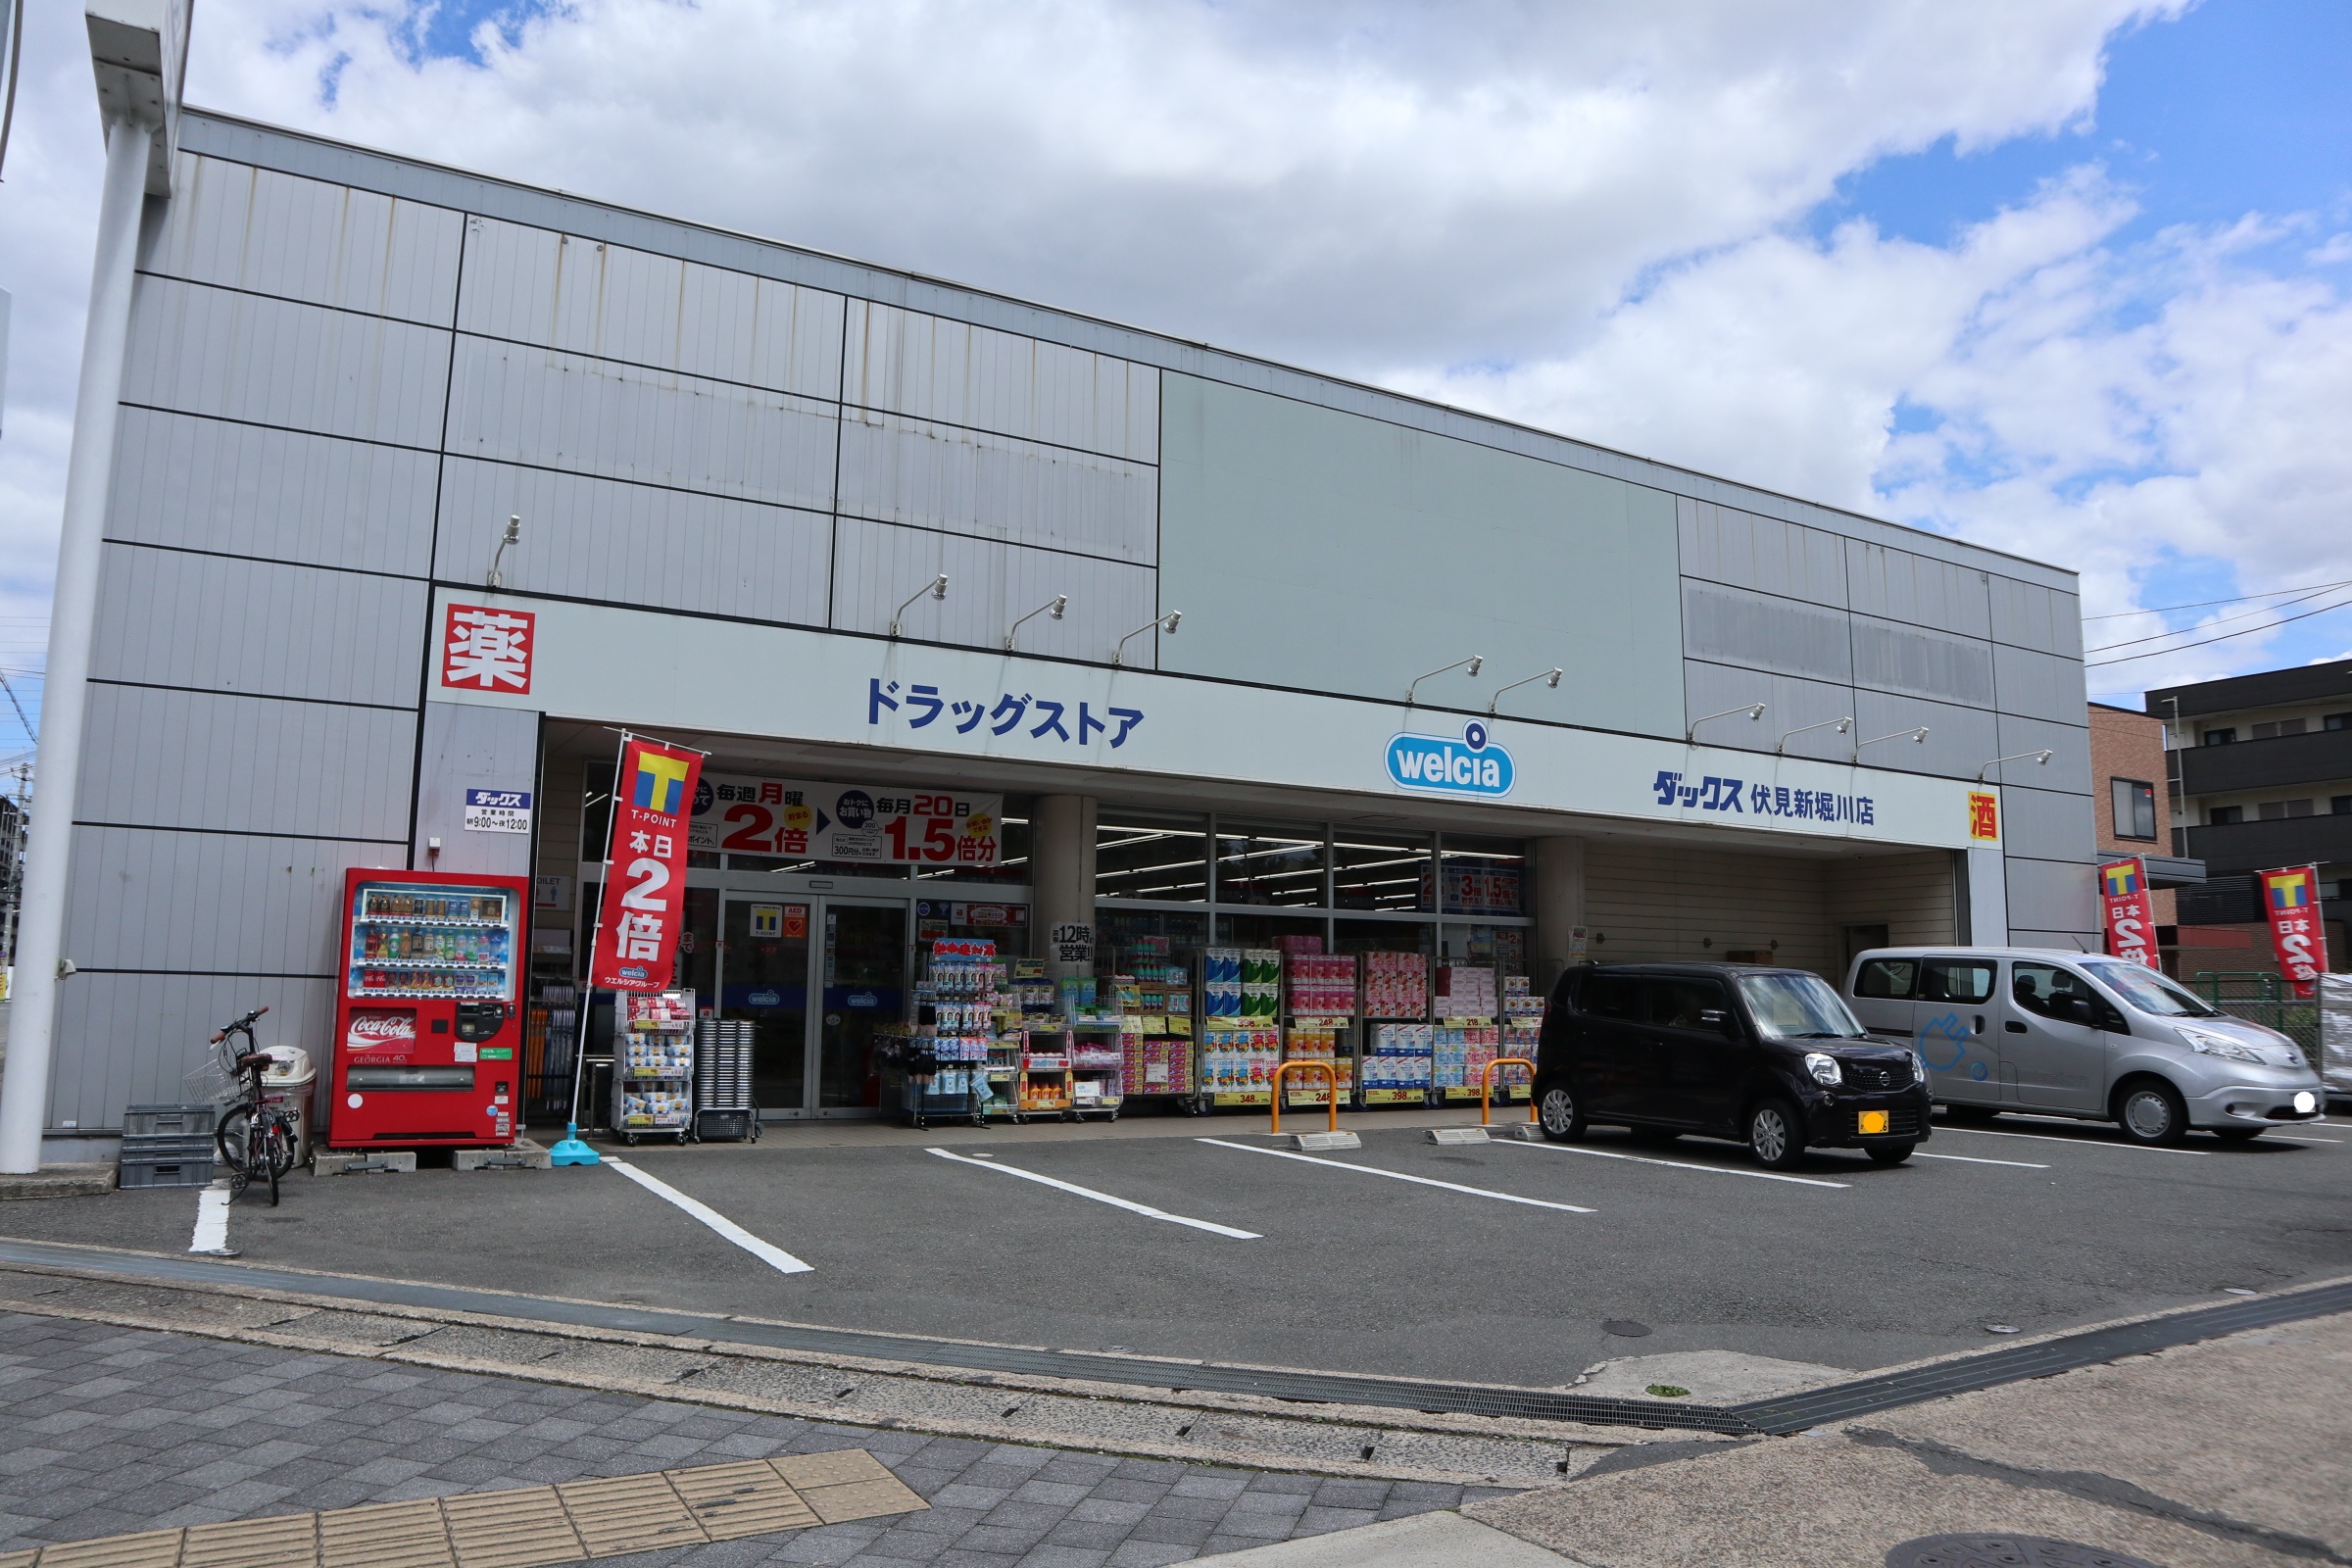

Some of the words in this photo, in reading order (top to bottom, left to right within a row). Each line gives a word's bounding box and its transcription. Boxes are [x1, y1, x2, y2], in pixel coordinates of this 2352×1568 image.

[447, 610, 528, 688] 薬
[868, 677, 1145, 749] ドラッグストア
[1396, 723, 1500, 788] welcia
[475, 791, 521, 807] ダックス
[716, 782, 804, 808] 毎週月曜
[876, 794, 970, 817] 毎月20日
[1653, 770, 1743, 813] ダックス
[1750, 783, 1875, 826] 伏見新堀川店
[481, 808, 514, 817] 営業時間
[631, 808, 676, 828] T-POINT
[839, 806, 872, 819] お買い物
[1970, 794, 1996, 838] 酒
[628, 830, 672, 858] 本日
[884, 815, 997, 862] 1.5倍分
[604, 976, 660, 988] ウエルシアグループ
[620, 966, 646, 978] welcia
[751, 991, 777, 1004] welcia
[849, 993, 875, 1005] welcia
[350, 1015, 416, 1036] Coca-Cola
[1392, 1092, 1407, 1101] 398
